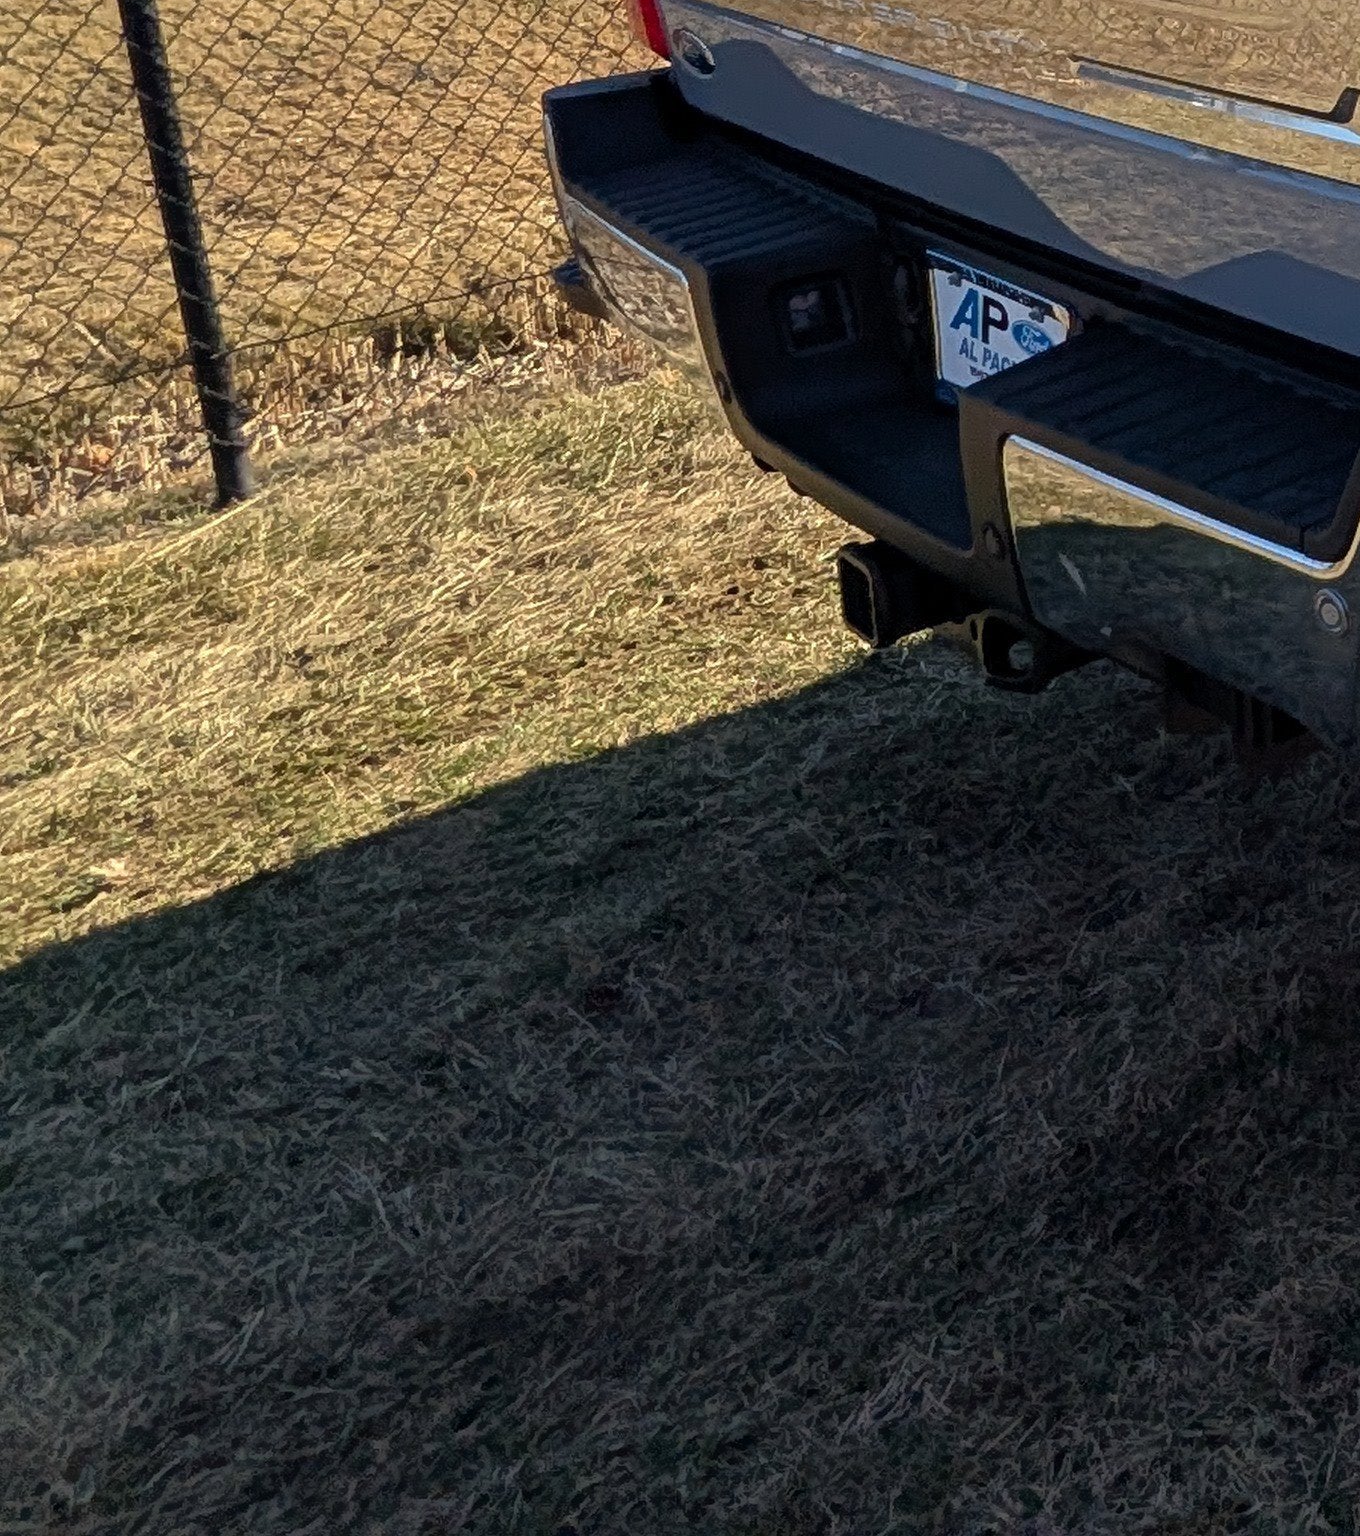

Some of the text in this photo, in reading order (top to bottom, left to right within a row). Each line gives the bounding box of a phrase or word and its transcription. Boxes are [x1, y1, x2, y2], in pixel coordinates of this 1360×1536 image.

[950, 287, 1010, 345] AP
[959, 337, 1019, 370] AL PAC
